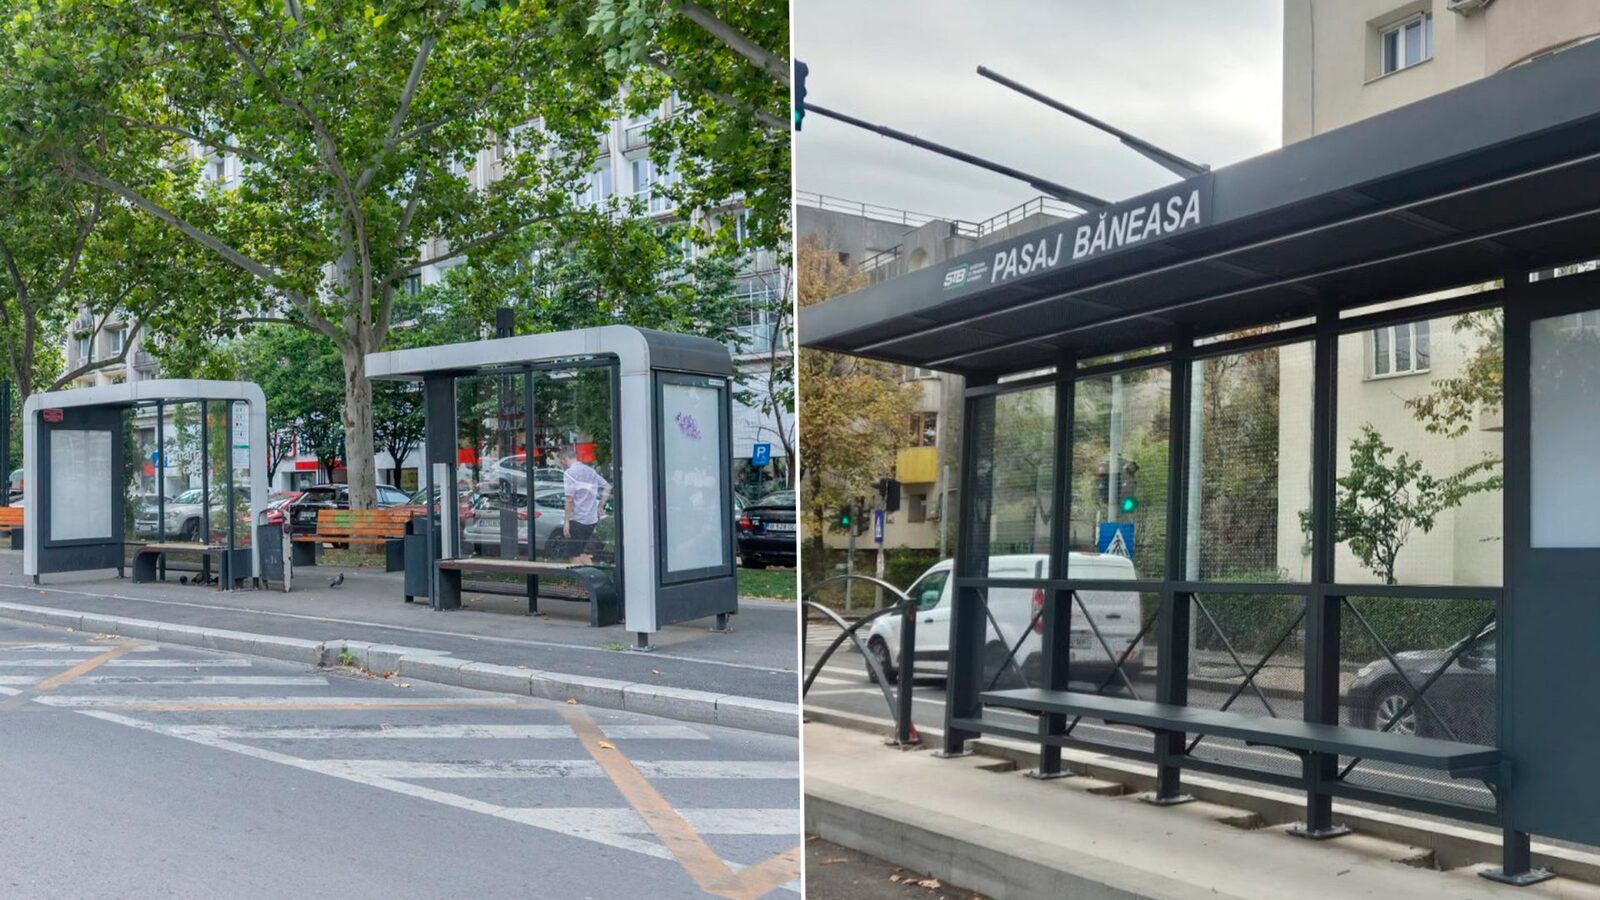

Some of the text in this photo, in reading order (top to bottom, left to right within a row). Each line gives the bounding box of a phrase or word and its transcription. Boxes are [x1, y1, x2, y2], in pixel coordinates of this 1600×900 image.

[991, 189, 1200, 284] PASAJ BĂNEASA
[943, 268, 966, 287] STB
